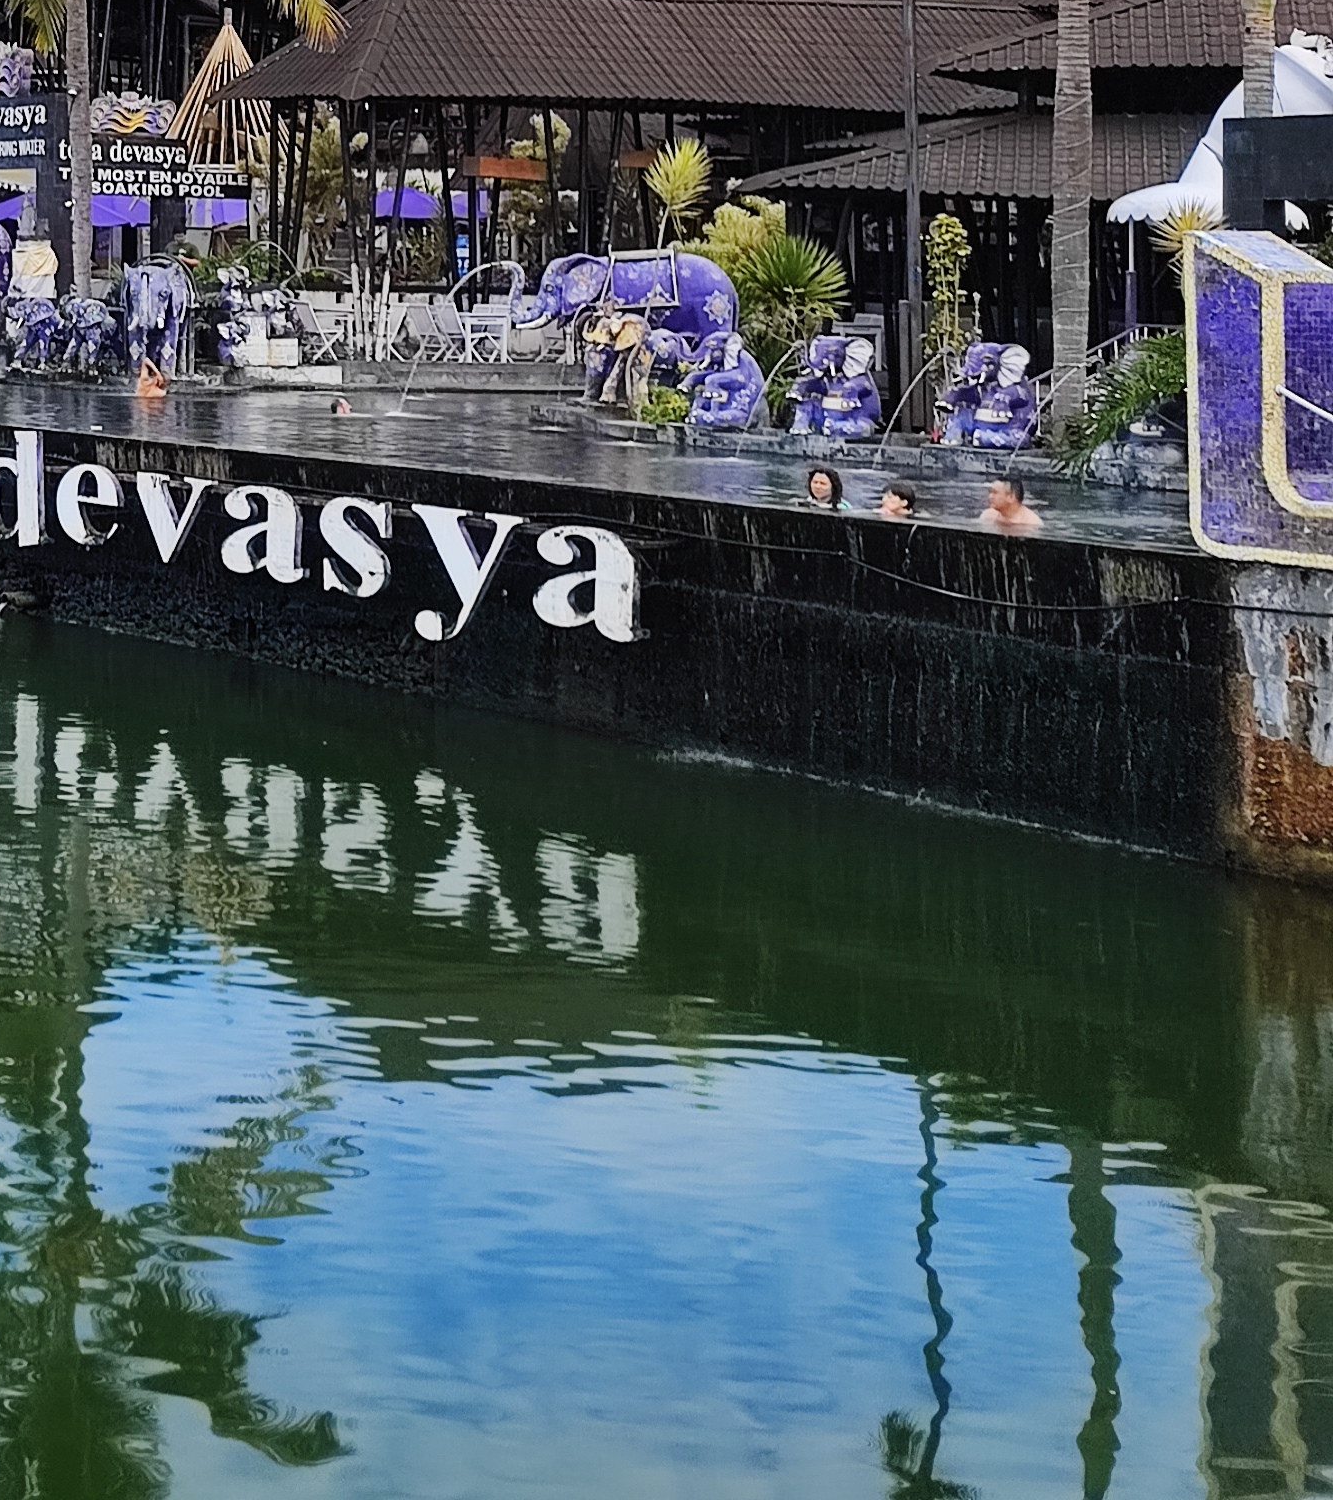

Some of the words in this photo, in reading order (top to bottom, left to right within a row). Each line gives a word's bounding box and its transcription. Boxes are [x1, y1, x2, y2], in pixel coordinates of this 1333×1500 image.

[18, 138, 46, 157] WATER
[58, 138, 102, 162] toa
[109, 138, 187, 170] devasya
[97, 167, 148, 184] MOST
[149, 170, 249, 187] ENJOYABLE
[91, 181, 174, 197] SOAKING
[178, 184, 225, 199] POOL
